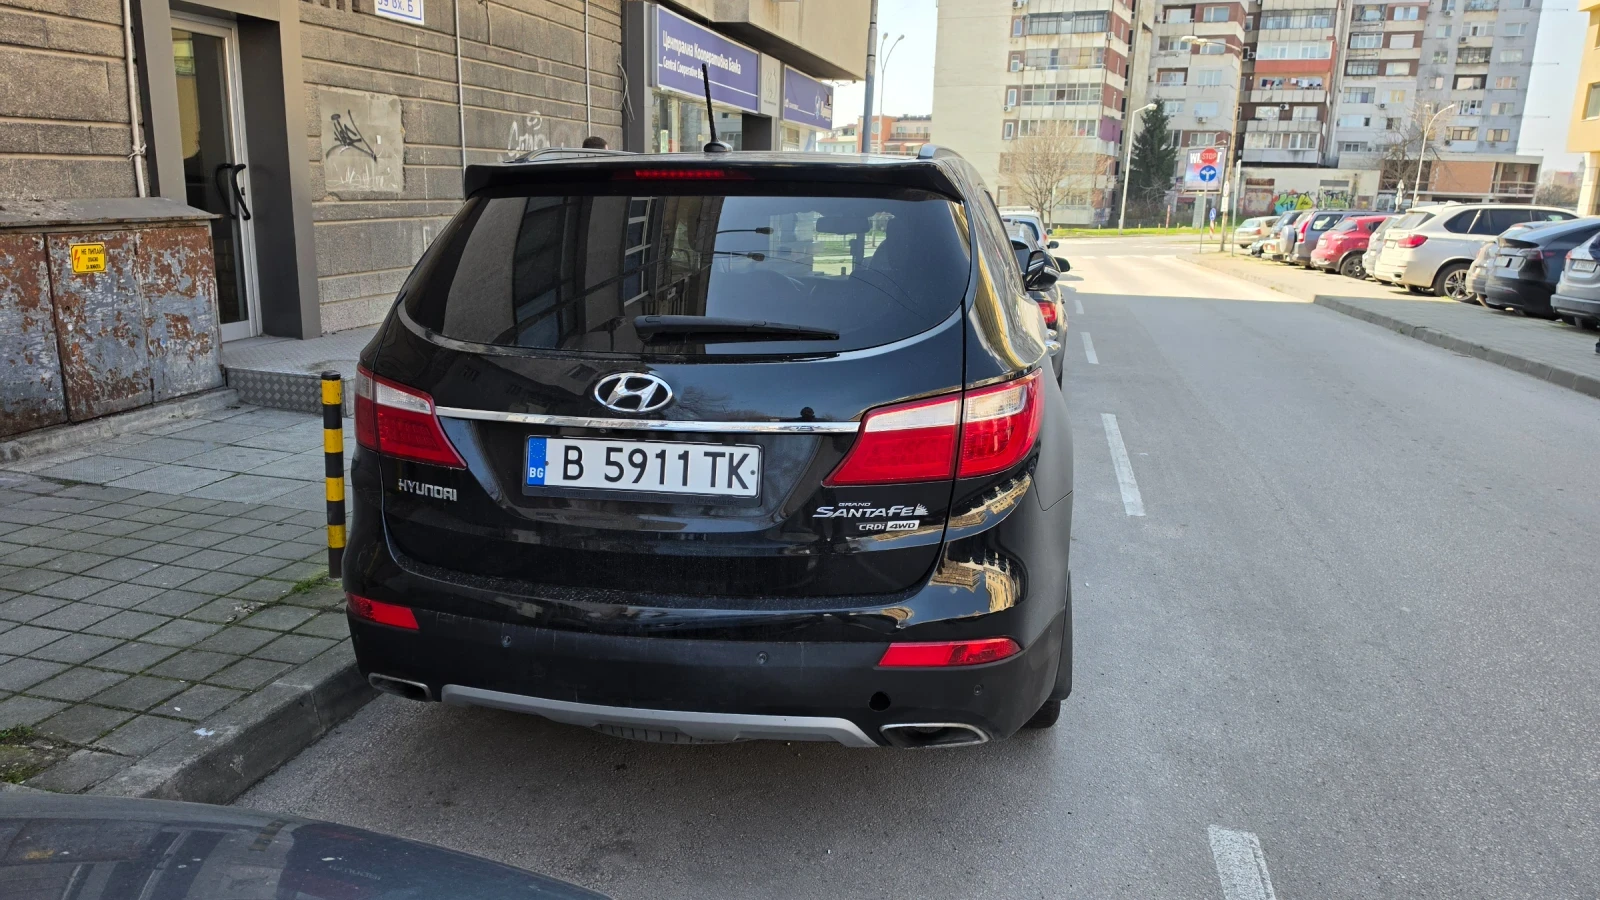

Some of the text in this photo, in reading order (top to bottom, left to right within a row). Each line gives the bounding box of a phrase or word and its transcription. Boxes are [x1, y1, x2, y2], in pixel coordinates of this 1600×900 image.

[662, 30, 741, 74] Централна Кооперативна Банка
[663, 56, 677, 72] Central
[677, 61, 698, 78] Cooperative
[529, 467, 544, 478] BG
[562, 445, 750, 490] B 5911 TK
[398, 478, 457, 502] HYUNDAI
[858, 522, 916, 531] CRDi 4WD
